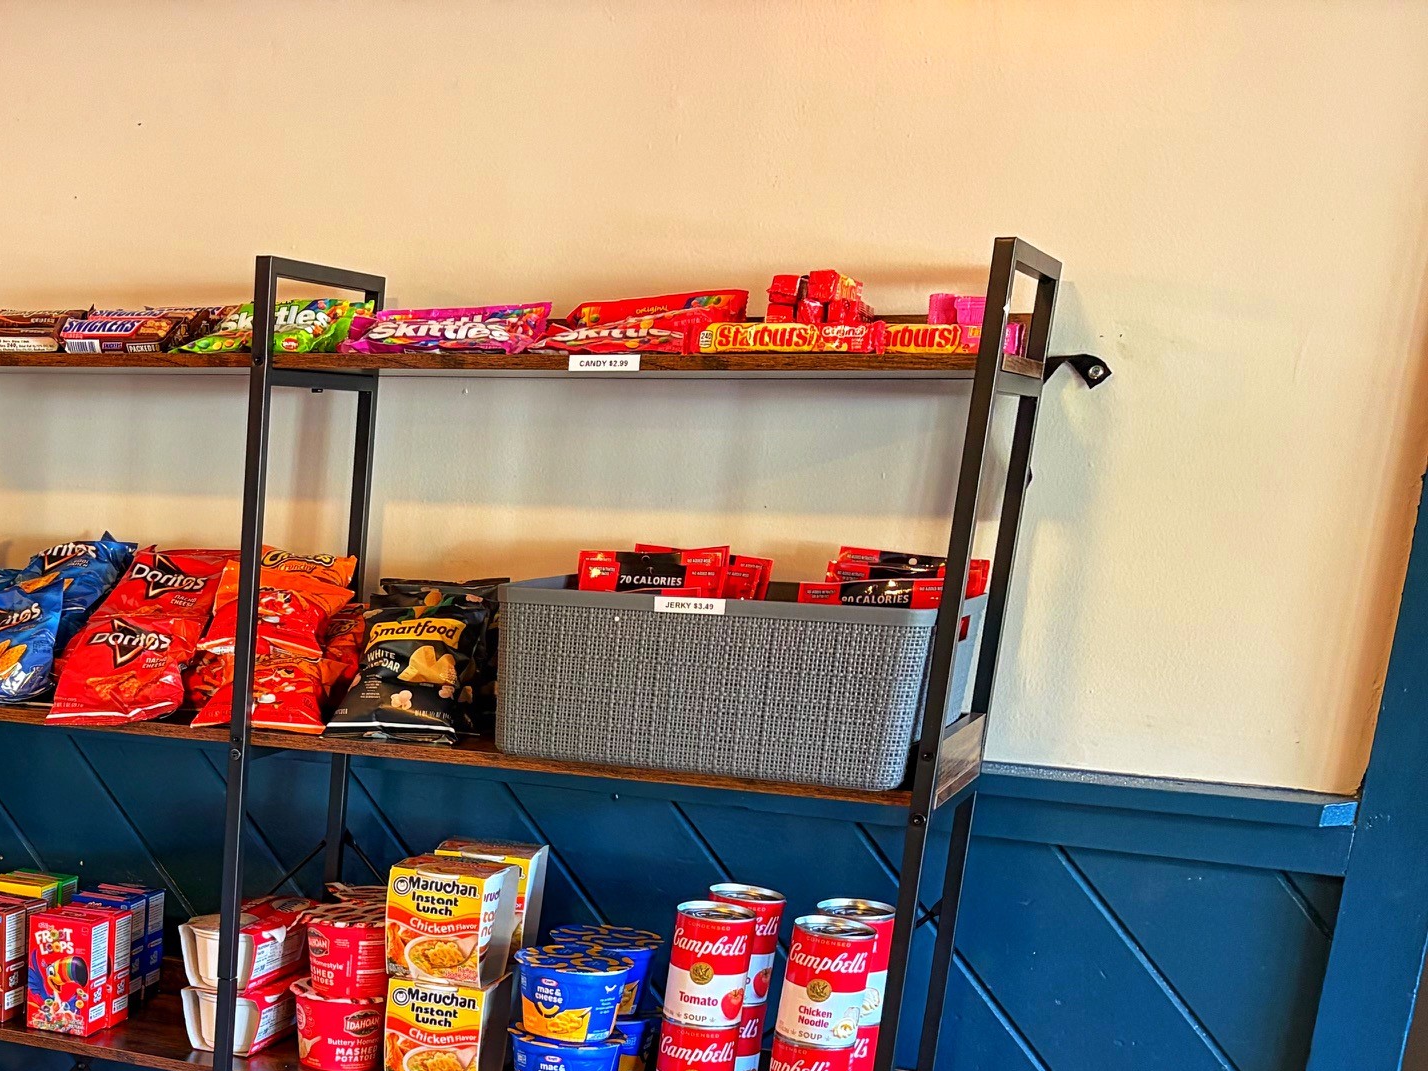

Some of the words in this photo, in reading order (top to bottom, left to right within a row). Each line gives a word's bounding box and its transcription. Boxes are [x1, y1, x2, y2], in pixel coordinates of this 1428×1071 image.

[222, 305, 331, 331] Sktles
[63, 320, 140, 333] SNICKERS
[369, 315, 510, 342] Skittles
[718, 325, 817, 347] Starburst
[132, 563, 207, 590] Doritos
[620, 575, 632, 584] 70
[633, 576, 682, 586] CALORIES
[693, 602, 714, 610] $3.49
[856, 595, 909, 604] CALORIES
[370, 620, 460, 643] Smartfood
[89, 632, 172, 650] Doritos
[367, 649, 396, 662] WHITE
[409, 876, 478, 898] Maruchan
[412, 891, 458, 908] Instant
[416, 904, 453, 916] Lunch
[410, 917, 455, 934] Chicken
[455, 923, 477, 931] Flavor
[688, 921, 731, 931] CONDENSED
[35, 928, 73, 944] FROOT
[674, 926, 748, 957] Campbell's
[806, 935, 852, 948] CONDENSED
[39, 941, 74, 955] LOOPS
[790, 940, 868, 974] Campbell's
[408, 987, 477, 1010] Maruchan
[537, 986, 554, 994] mac
[554, 988, 561, 997] &
[679, 990, 718, 1007] Tomato
[411, 1002, 458, 1019] Instant
[798, 1005, 832, 1019] Chicken
[347, 1016, 379, 1030] IDAHOAN
[415, 1014, 452, 1028] Lunch
[683, 1013, 707, 1023] SOUP
[798, 1015, 829, 1028] Noodle
[327, 1038, 355, 1047] Buttery
[357, 1037, 379, 1046] Homes
[409, 1028, 454, 1044] Chicken
[455, 1034, 477, 1042] Flavor
[798, 1030, 823, 1041] SOUP
[335, 1045, 377, 1056] MASHED
[660, 1034, 735, 1065] Campbell's
[540, 1063, 558, 1071] mac
[559, 1064, 565, 1071] &
